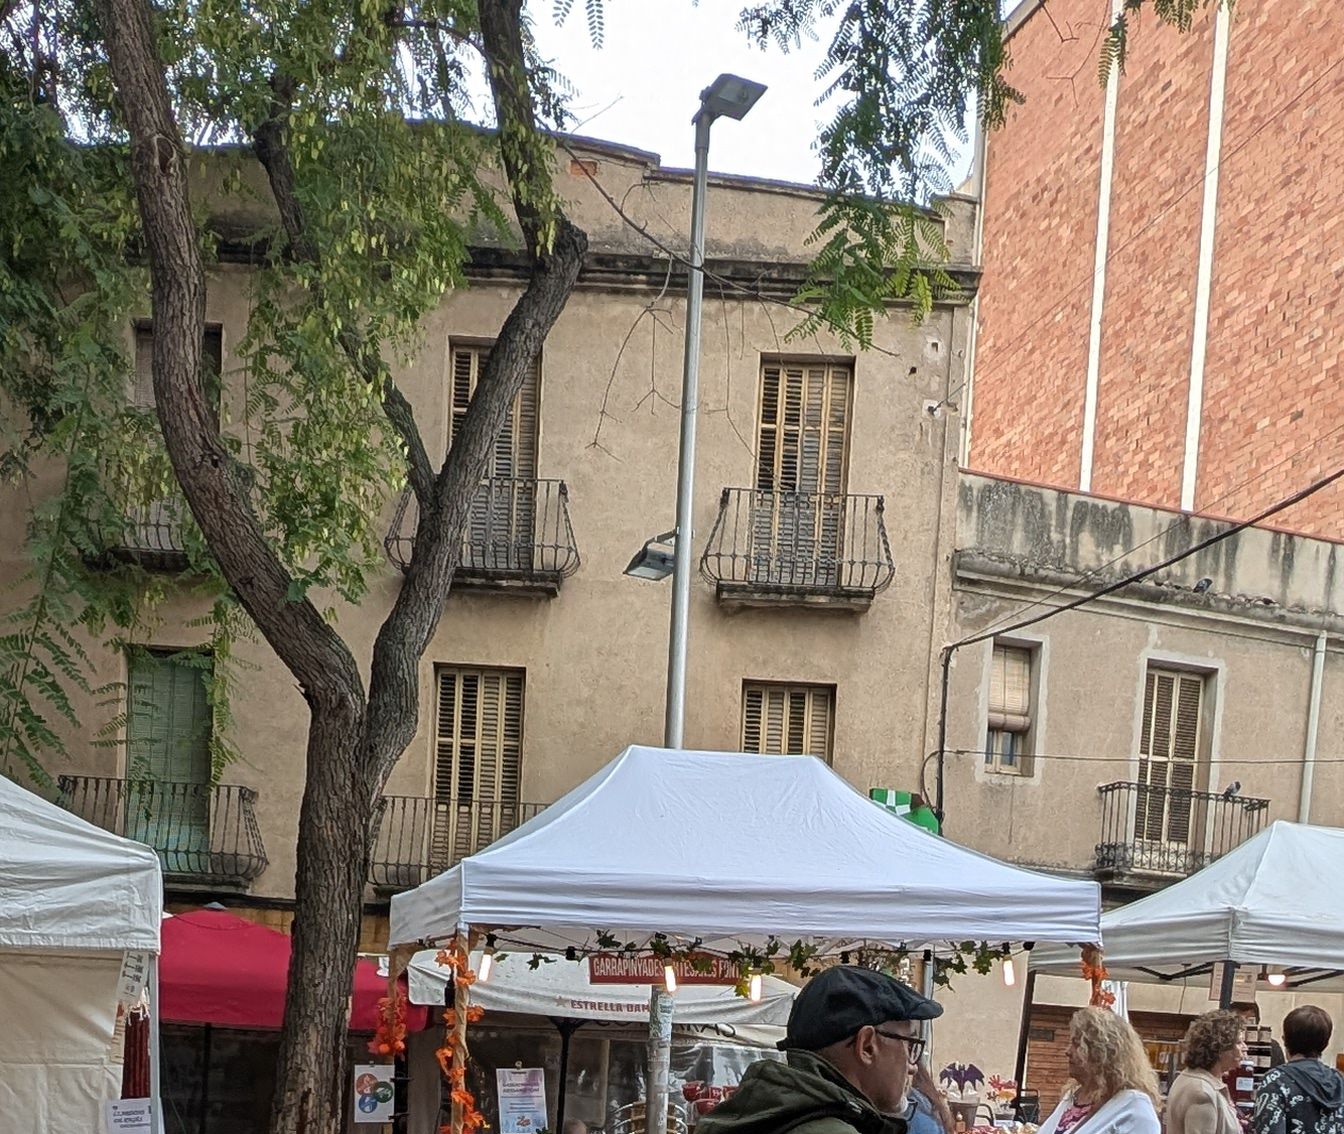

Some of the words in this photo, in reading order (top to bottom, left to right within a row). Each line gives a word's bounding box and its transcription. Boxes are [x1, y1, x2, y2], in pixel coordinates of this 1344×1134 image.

[593, 957, 664, 977] GARRAPINYADES
[571, 1000, 623, 1012] ESTRELLA
[626, 1003, 650, 1013] DAM
